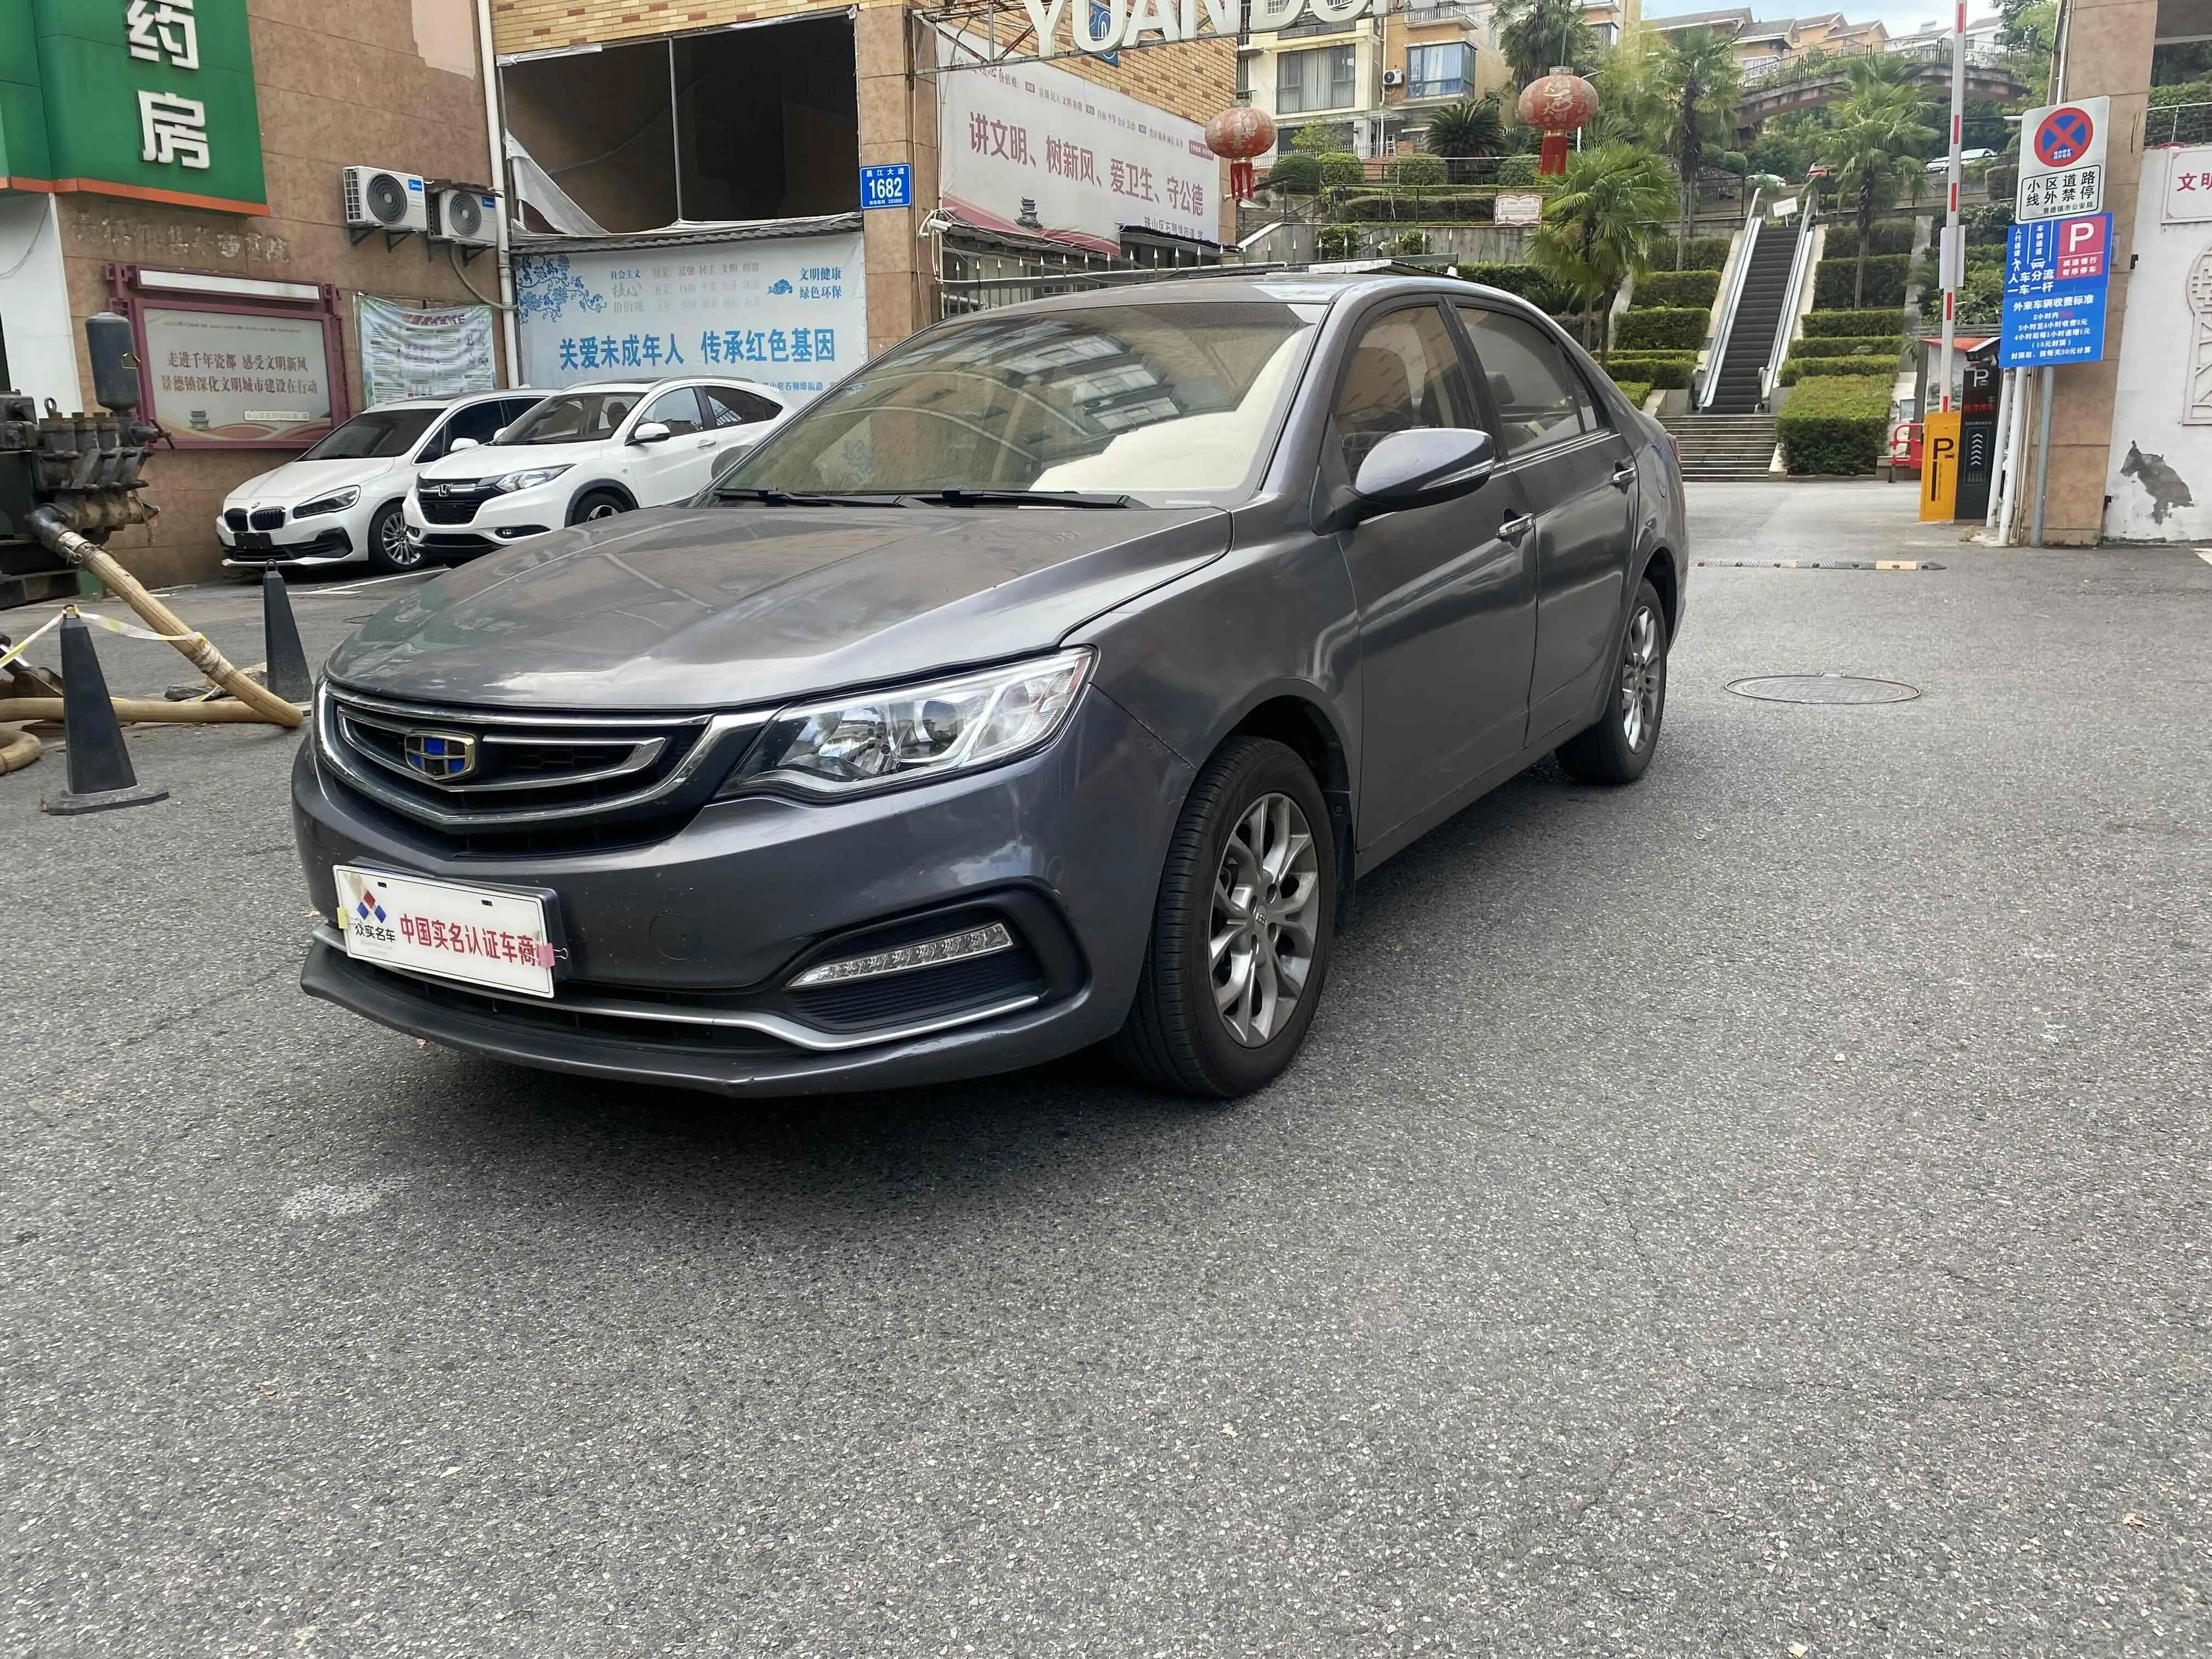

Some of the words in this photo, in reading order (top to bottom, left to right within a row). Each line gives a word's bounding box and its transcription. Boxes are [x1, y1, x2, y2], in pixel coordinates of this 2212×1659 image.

[127, 0, 210, 169] 药房
[869, 177, 902, 199] 1682
[2027, 171, 2095, 192] 小区道路
[2026, 185, 2095, 206] 线外禁停
[2043, 201, 2093, 215] 景德镇市公安局
[2069, 222, 2094, 252] P
[611, 269, 641, 280] 社会主义
[799, 267, 842, 281] 文明健康
[2007, 268, 2055, 284] 人车分流
[799, 285, 843, 299] 绿色环保
[2007, 281, 2054, 295] 一车一杆
[2013, 294, 2094, 312] 外来车辆收费标准
[560, 333, 685, 370] 关爱未成年人
[701, 328, 836, 364] 传承红色基因
[167, 351, 236, 370] 走进千年瓷都
[242, 354, 308, 372] 感受文明新风
[161, 375, 318, 394] 景德镇深化文明城市建设在行动
[354, 922, 396, 944] 众实名车
[399, 913, 540, 967] 中国实名认证车商
